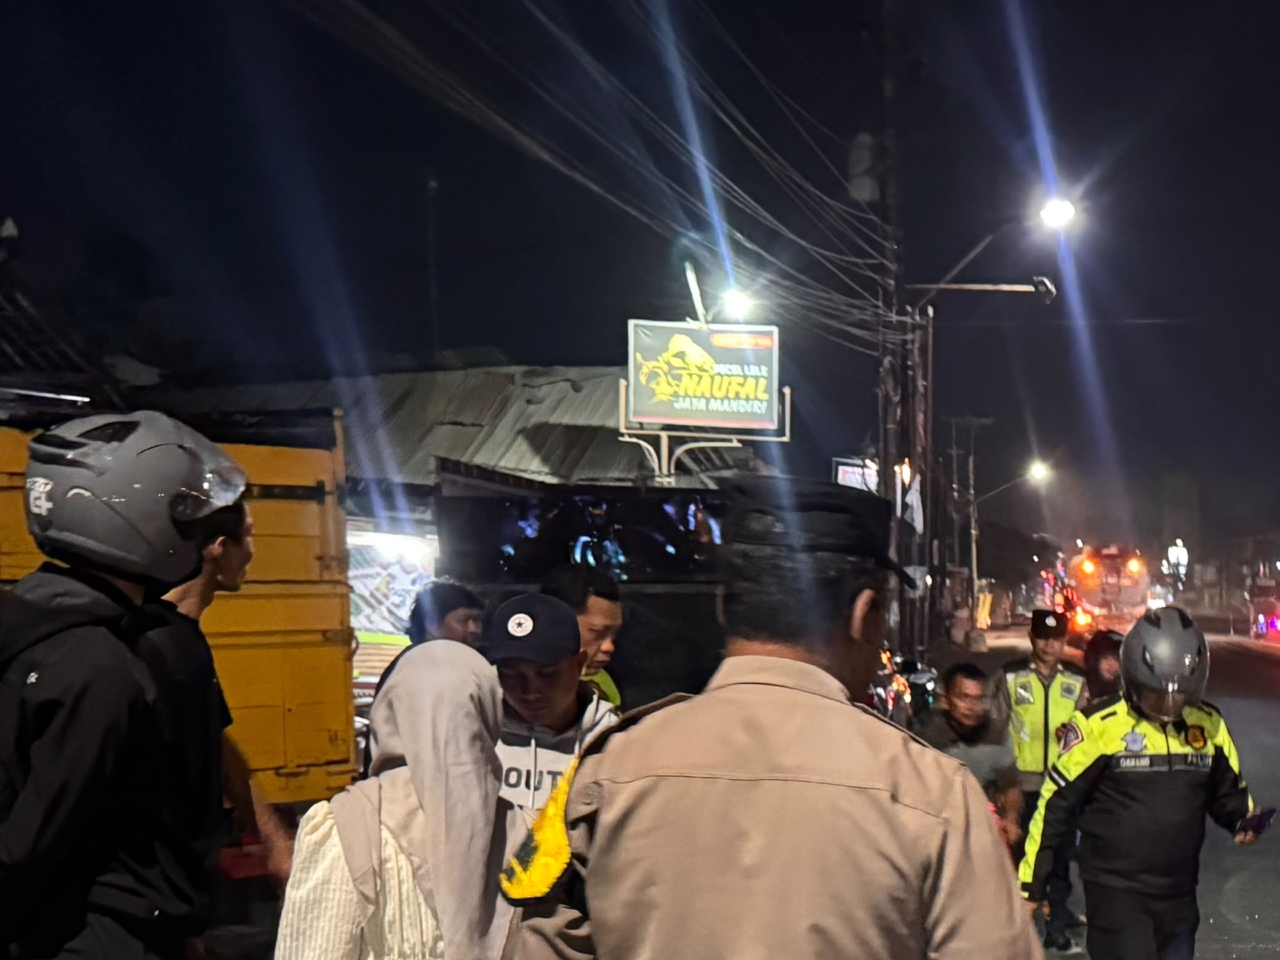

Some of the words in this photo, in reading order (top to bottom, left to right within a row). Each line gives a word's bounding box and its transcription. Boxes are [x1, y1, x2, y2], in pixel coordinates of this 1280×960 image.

[679, 372, 770, 400] NAUFAL
[673, 396, 706, 411] JAYA
[708, 398, 768, 414] MANDIRI
